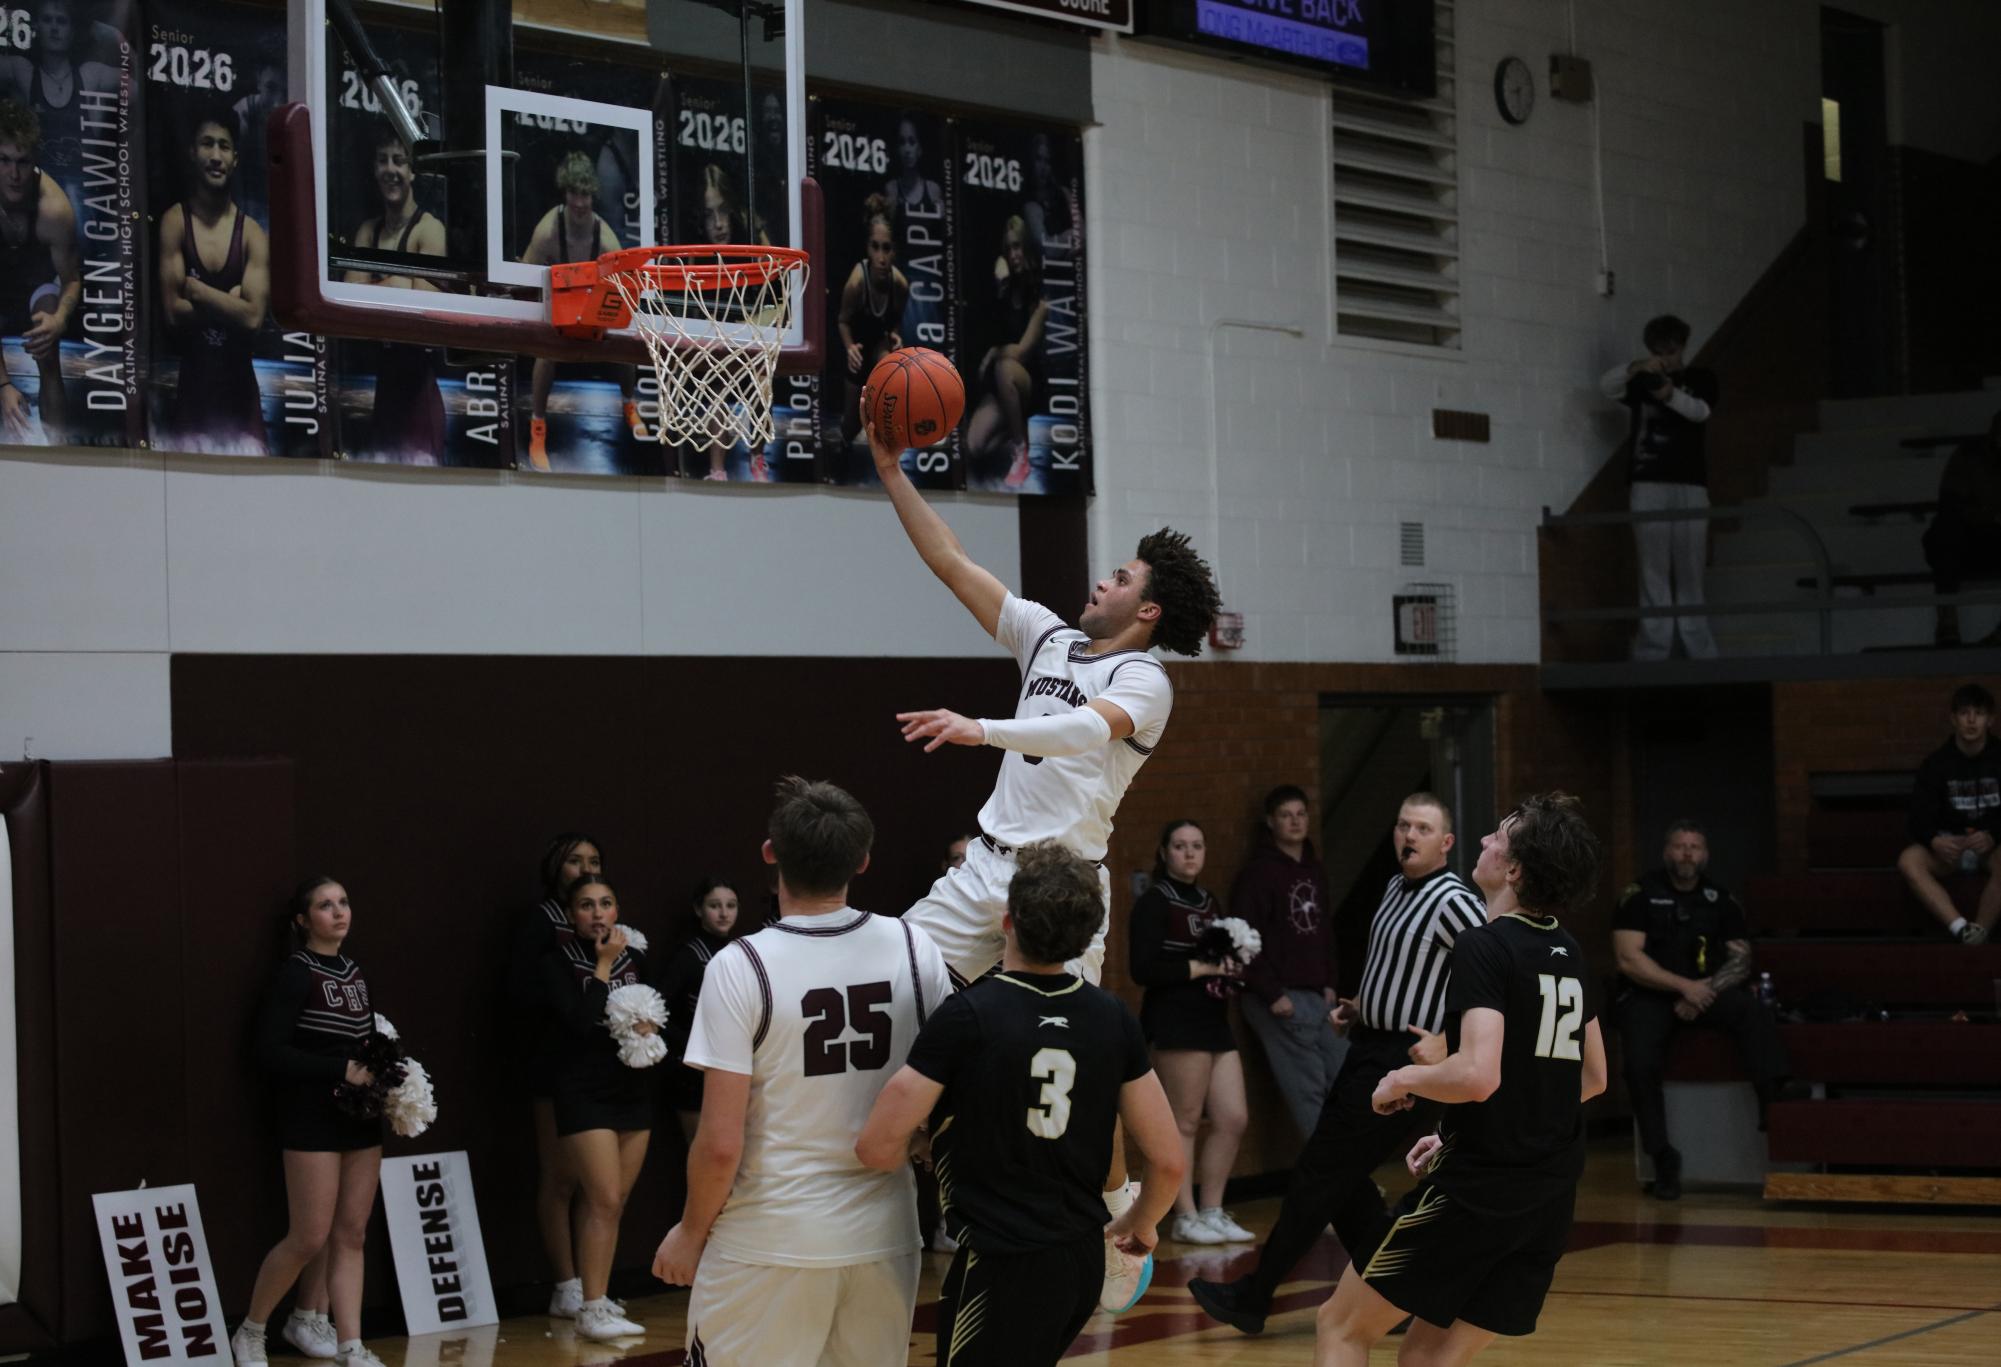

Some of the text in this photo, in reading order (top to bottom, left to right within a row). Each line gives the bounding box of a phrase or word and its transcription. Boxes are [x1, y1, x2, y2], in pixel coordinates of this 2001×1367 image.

[151, 25, 194, 44] Senior
[1202, 9, 1241, 41] ONG
[1301, 0, 1364, 26] BACK
[148, 43, 237, 92] 2026
[339, 70, 423, 118] 206
[655, 119, 669, 199] WRESTLING
[677, 109, 746, 154] 2026
[821, 131, 890, 175] 2026
[962, 152, 1024, 192] 2026
[79, 90, 128, 411] DAYGEN GAWITH
[119, 42, 137, 394] SALINA CENTRAL HIGH SCHOOL WRESTLING
[318, 360, 328, 414] SALINA
[1040, 233, 1080, 470] KODI WAITE
[466, 363, 499, 446] ABR
[500, 376, 510, 429] SALINA
[801, 981, 893, 1077] 25
[1534, 973, 1584, 1061] 12
[1026, 1047, 1077, 1140] 3
[155, 1203, 217, 1358] NOISE
[412, 1161, 467, 1323] DEFENSE
[112, 1212, 171, 1360] MAKE
